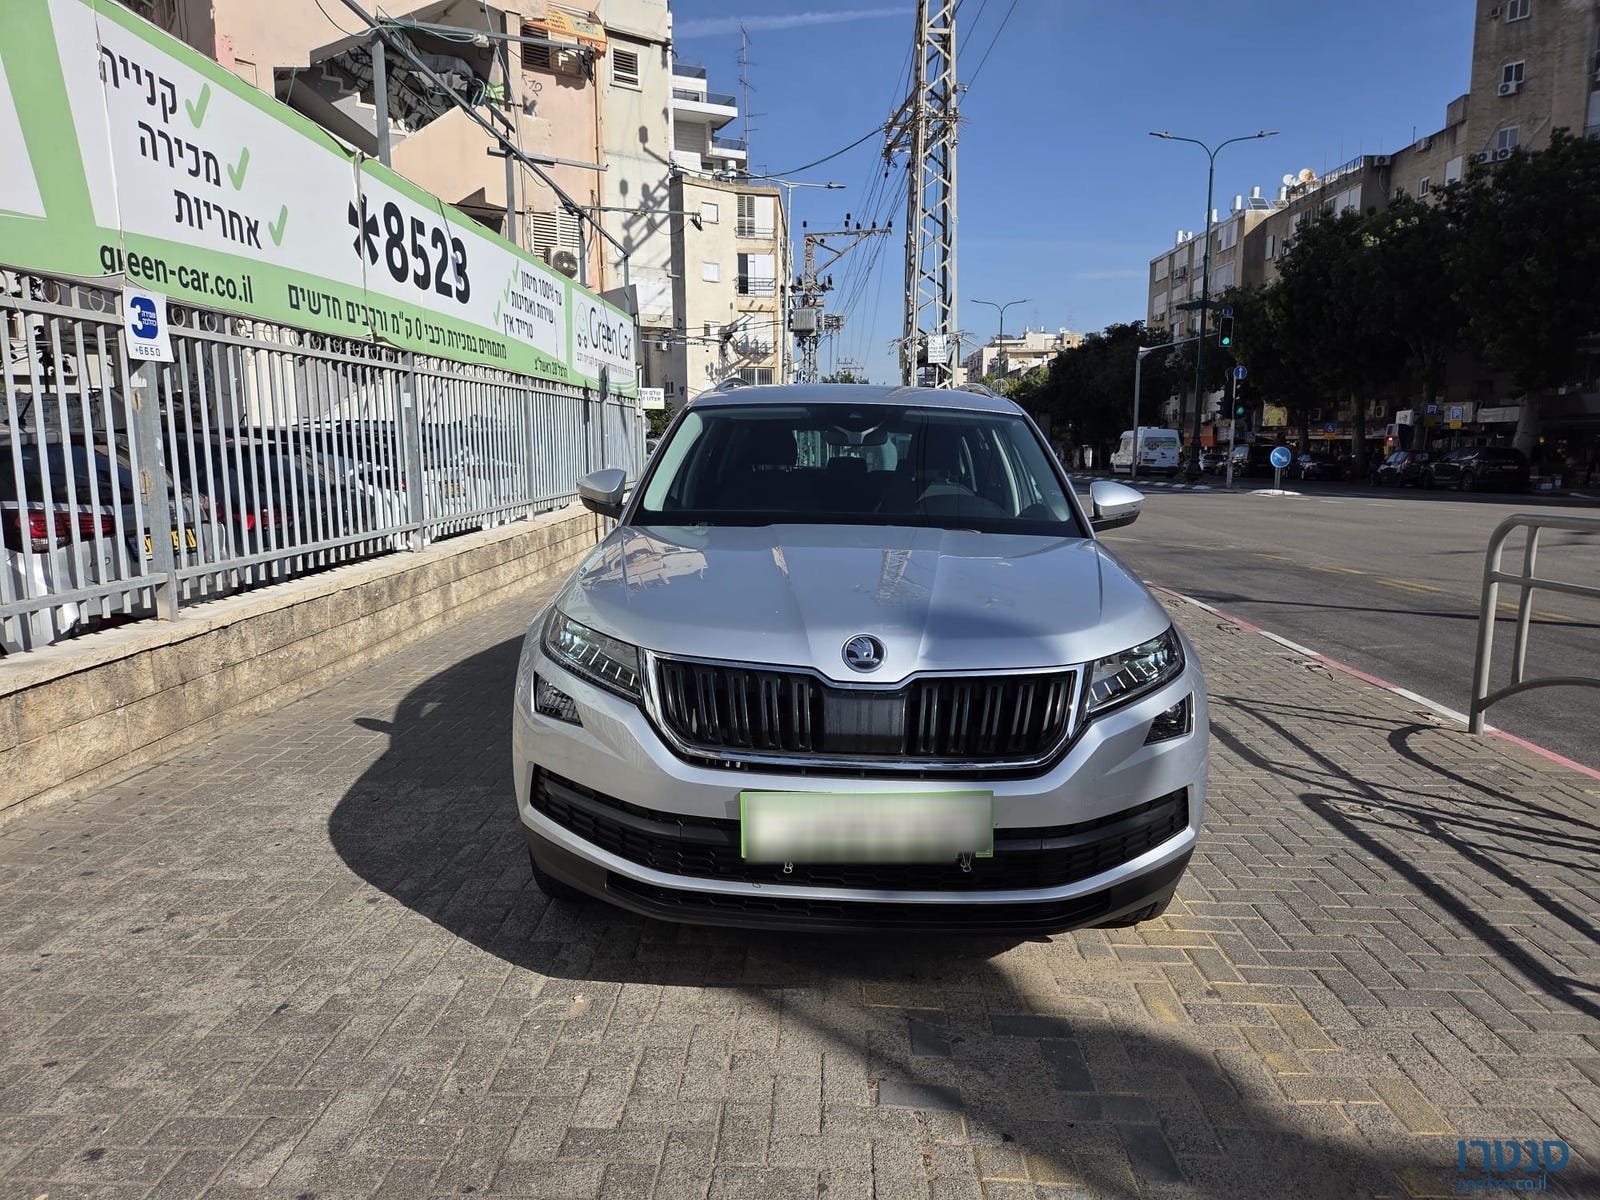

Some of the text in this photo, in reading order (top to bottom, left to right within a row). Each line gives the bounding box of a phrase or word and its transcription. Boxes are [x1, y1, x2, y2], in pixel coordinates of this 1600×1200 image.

[100, 45, 178, 124] קנייה
[138, 120, 221, 187] מכירה
[173, 189, 262, 250] אחריות
[521, 270, 538, 294] מימון
[288, 284, 342, 320] חדשים
[346, 300, 388, 332] ורכבים
[511, 290, 554, 324] שירות ואמינות
[424, 324, 446, 346] רכבי
[448, 330, 478, 352] במכירת
[478, 338, 507, 359] מתמחים
[590, 306, 632, 360] Green Car
